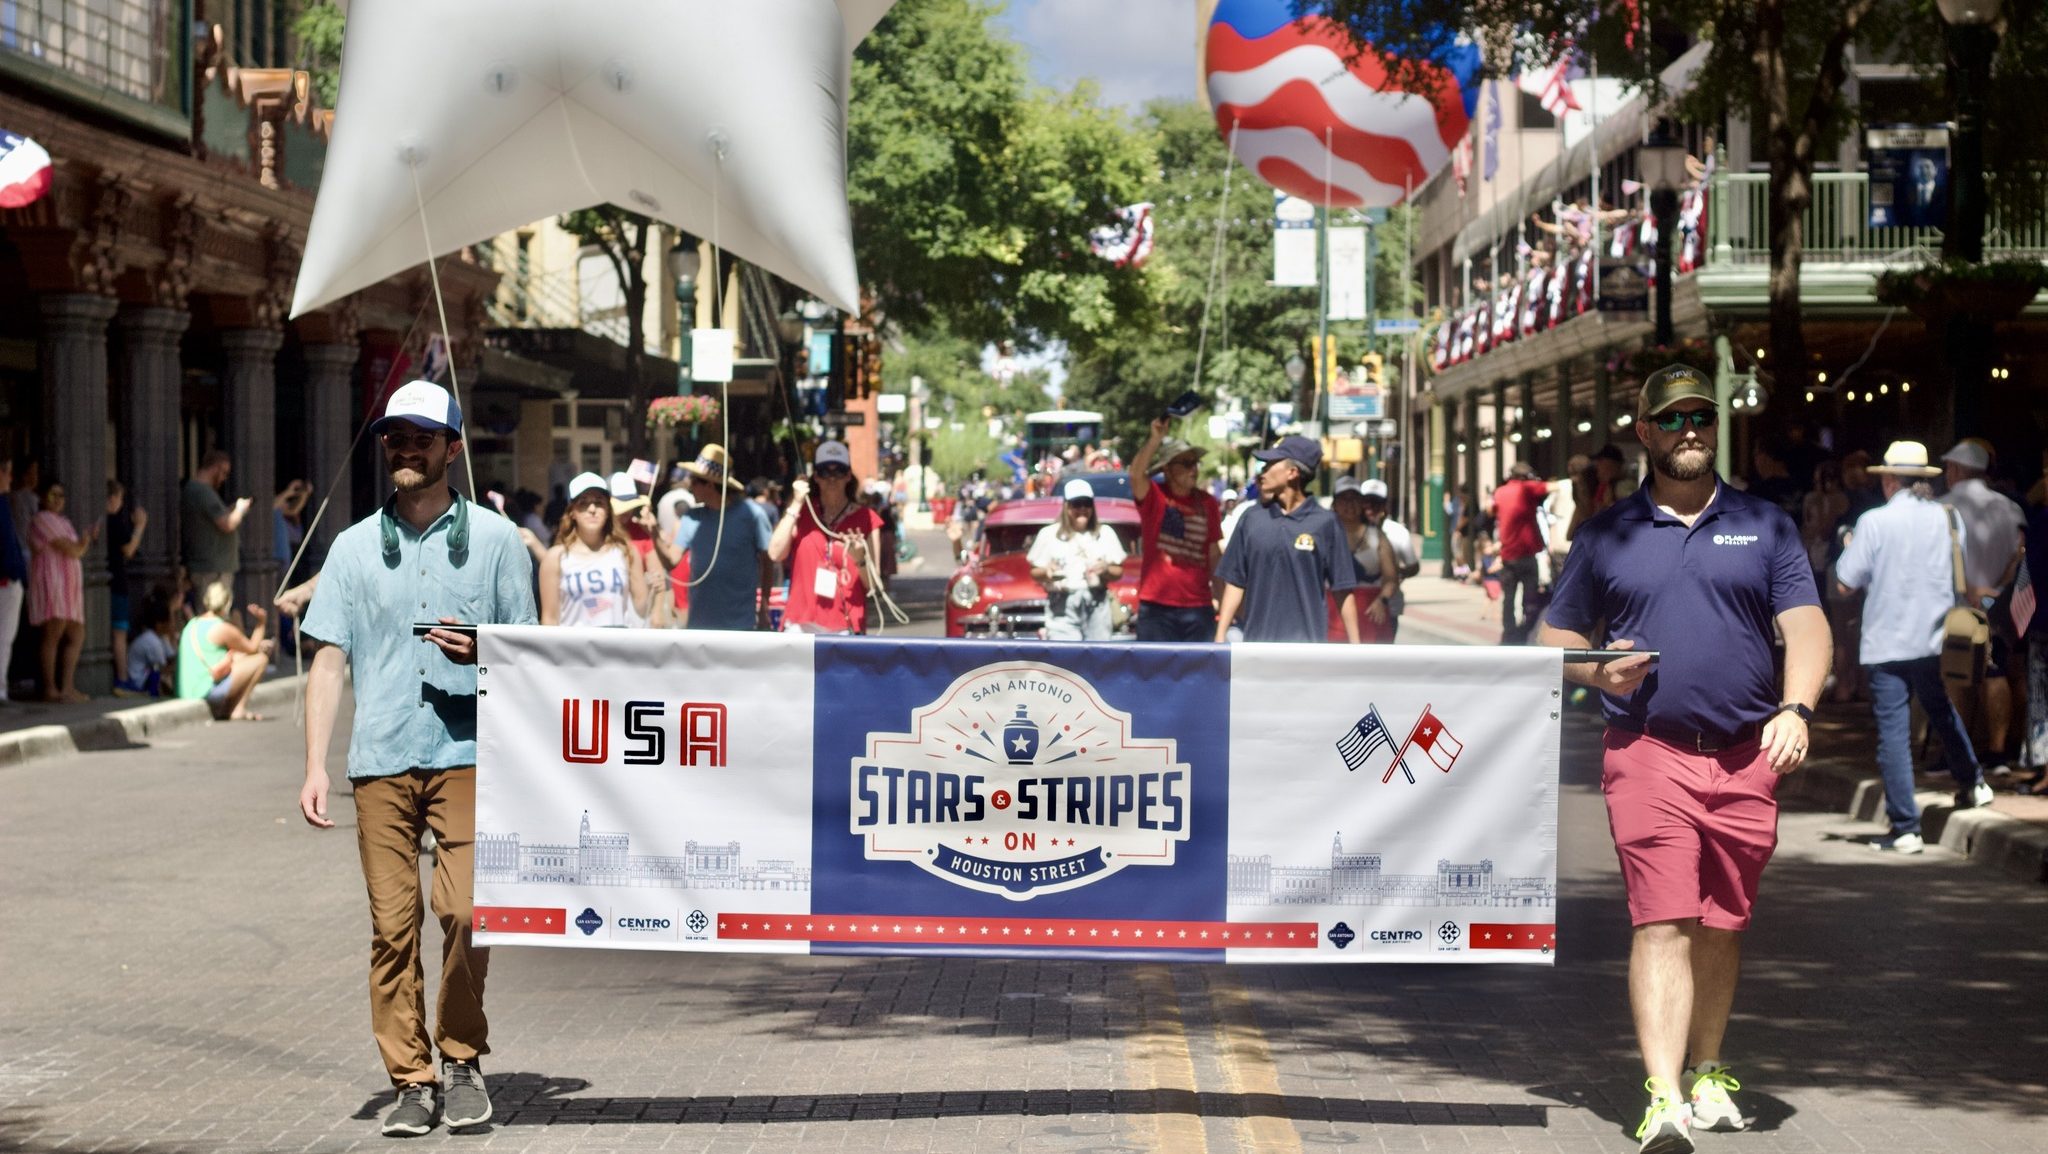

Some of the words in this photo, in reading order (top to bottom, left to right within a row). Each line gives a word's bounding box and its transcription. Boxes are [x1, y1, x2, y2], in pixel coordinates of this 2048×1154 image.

[564, 567, 625, 603] USA
[972, 682, 1001, 702] SAN
[1007, 679, 1072, 704] ANTONIO
[562, 698, 728, 767] USA
[858, 765, 985, 827] STARS
[1017, 770, 1184, 832] STRIPES
[1004, 832, 1036, 851] ON
[950, 855, 1022, 882] HOUSTON
[1030, 858, 1087, 882] STREET
[618, 917, 671, 929] CENTRO
[1370, 930, 1423, 941] CENTRO
